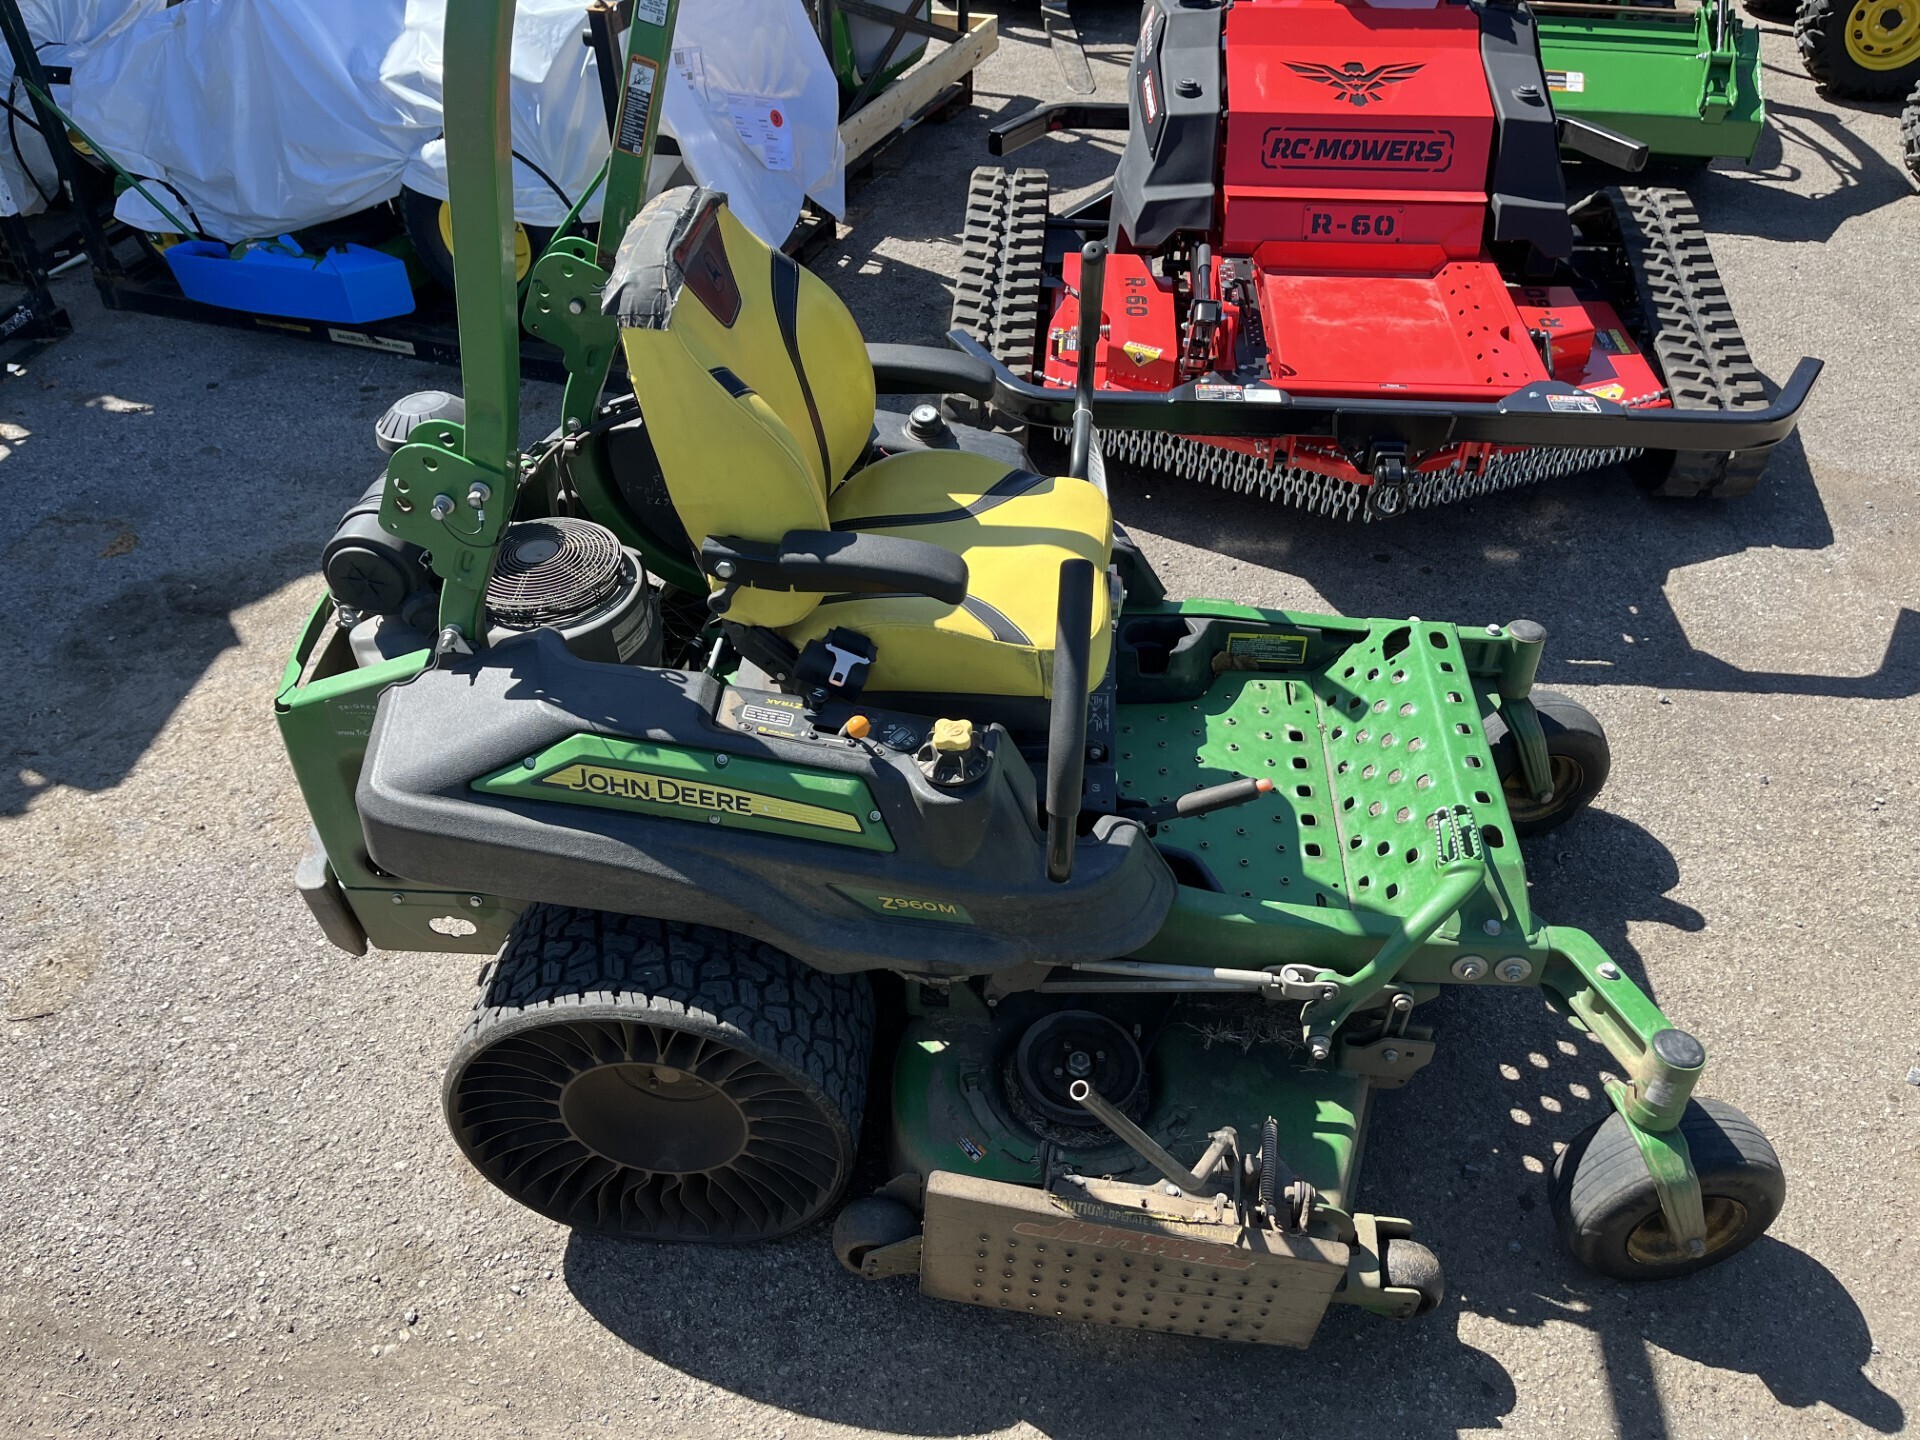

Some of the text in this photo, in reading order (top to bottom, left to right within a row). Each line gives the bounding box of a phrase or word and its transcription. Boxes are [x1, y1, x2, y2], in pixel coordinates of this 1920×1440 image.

[773, 113, 780, 122] 3
[1311, 213, 1395, 236] R-60
[1125, 277, 1148, 316] R-60
[572, 768, 752, 814] JOHN DEERE
[878, 896, 957, 914] Z960M
[1108, 1209, 1149, 1226] OPERATE
[1176, 1221, 1208, 1236] SHIELD
